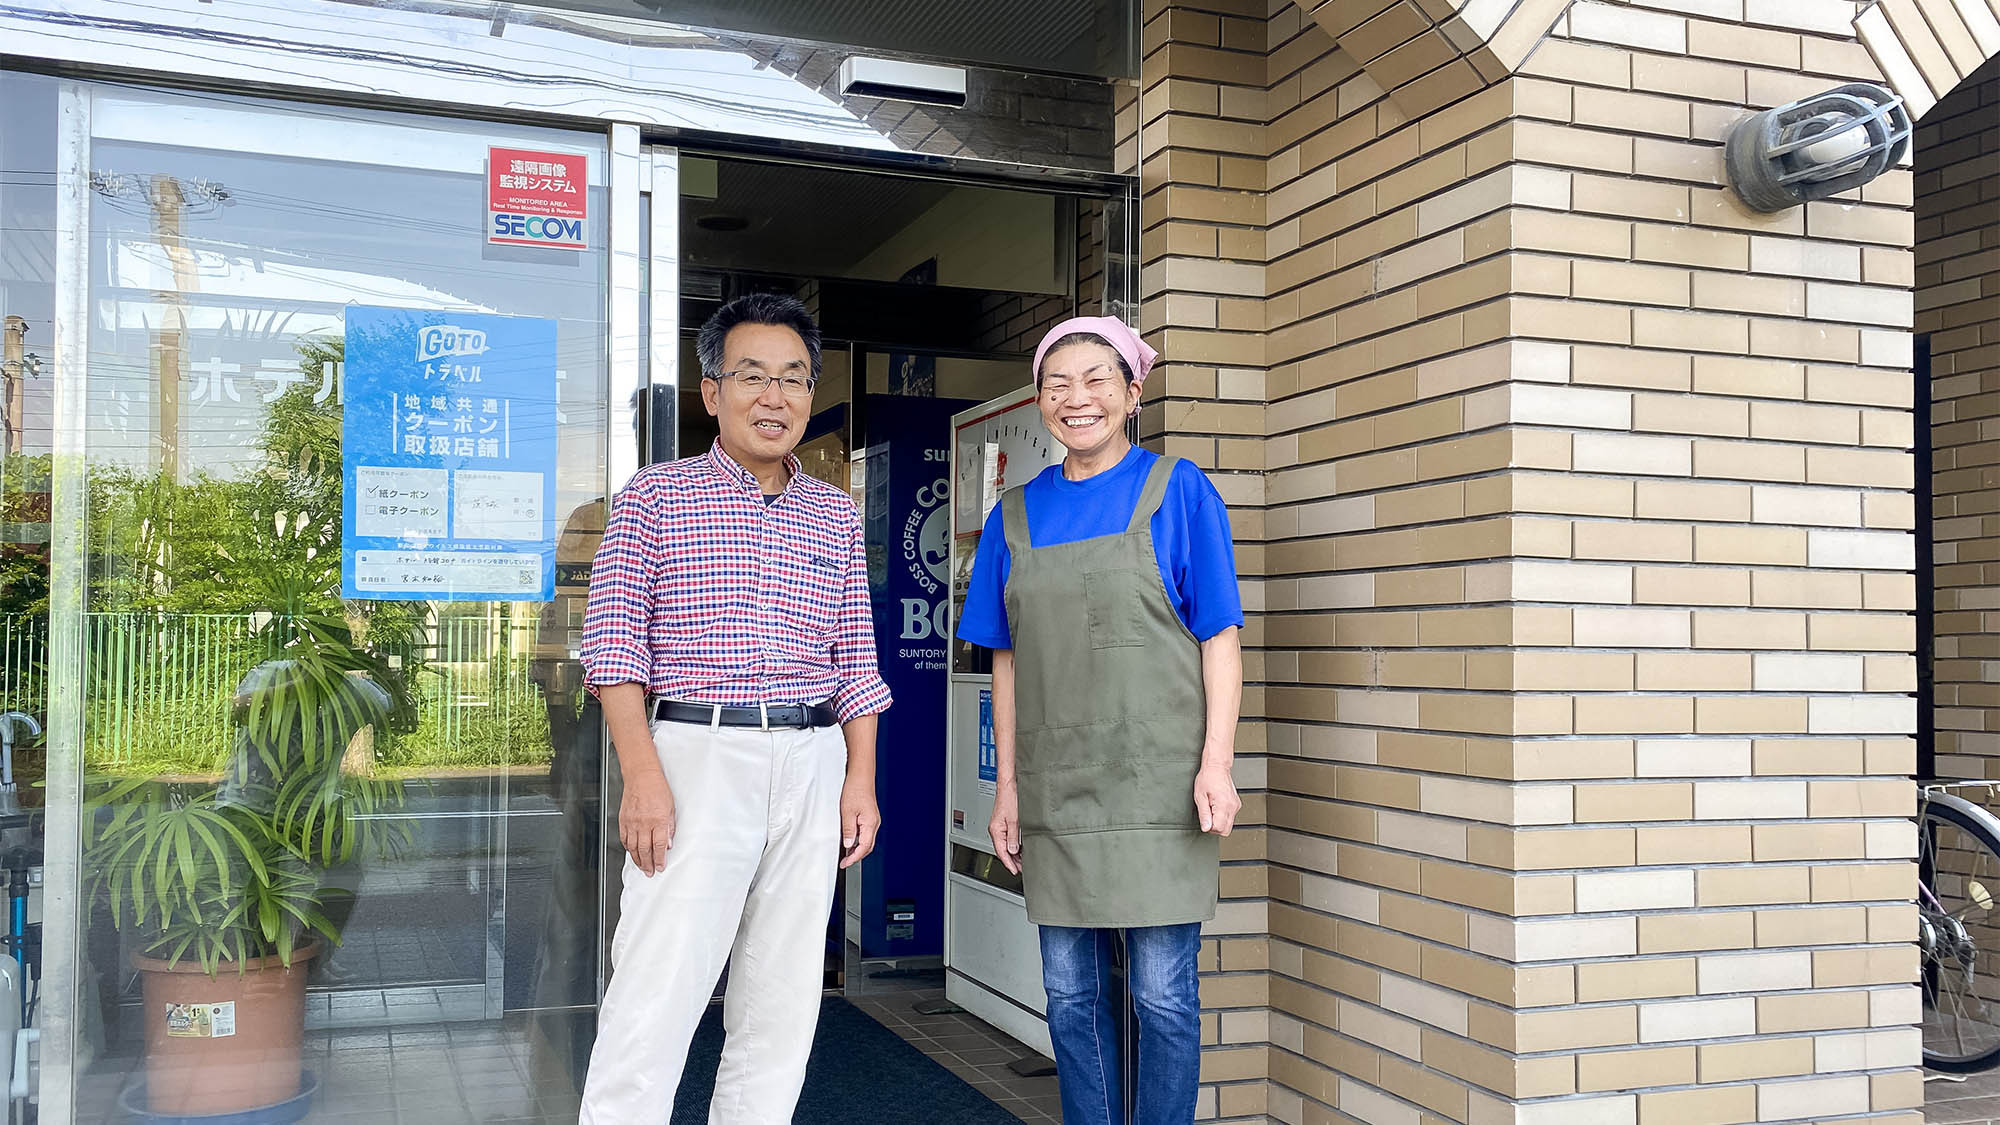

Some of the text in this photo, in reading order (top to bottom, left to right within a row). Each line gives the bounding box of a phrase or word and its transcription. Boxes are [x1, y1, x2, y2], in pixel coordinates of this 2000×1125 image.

[510, 159, 567, 178] 遠隔画像
[499, 174, 577, 194] 監視システム
[509, 197, 568, 208] MONITORED AREA
[521, 205, 550, 213] Monitoring
[495, 214, 581, 240] SECOM
[424, 362, 482, 382] トラベル
[404, 393, 498, 414] 地域共通
[404, 412, 498, 433] クーポン
[404, 434, 499, 458] 取扱店舗
[379, 489, 429, 499] 紙クーポン
[379, 505, 439, 516] 電子クーポン
[903, 508, 938, 594] BOSS COFFEE
[899, 648, 947, 658] SUNTORY
[914, 660, 947, 669] of them
